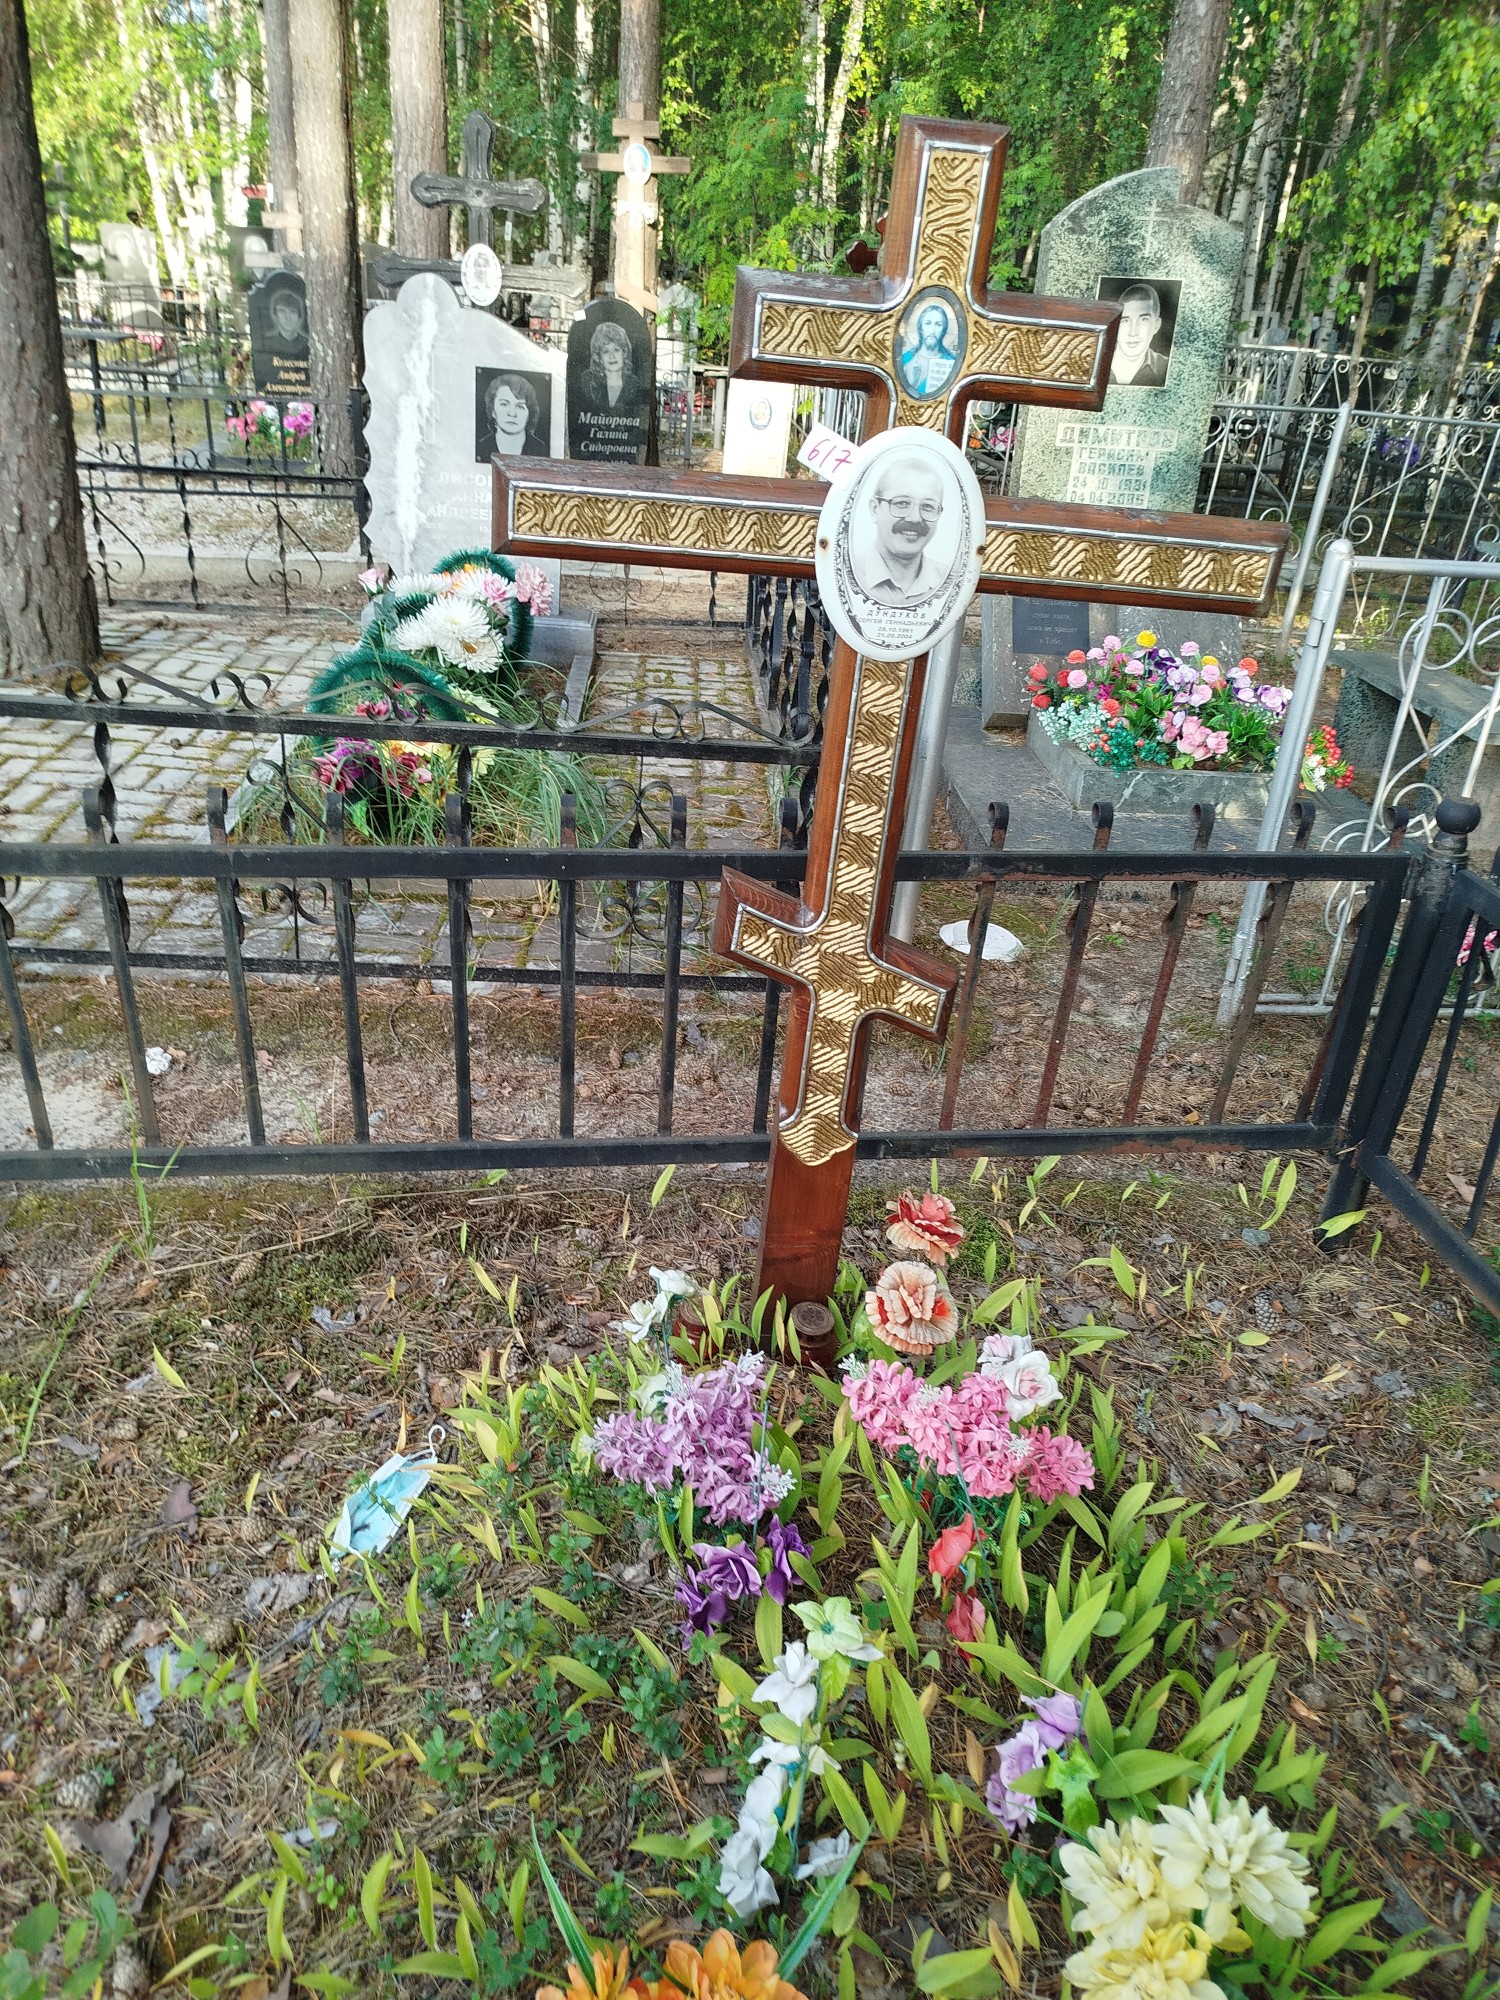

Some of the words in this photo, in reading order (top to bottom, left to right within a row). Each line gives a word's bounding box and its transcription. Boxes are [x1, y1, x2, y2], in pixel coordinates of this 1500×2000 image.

[578, 411, 640, 428] Майорова
[590, 427, 629, 440] Галина
[581, 440, 638, 455] Сидоровна
[867, 609, 926, 619] ДУНДУКОВ
